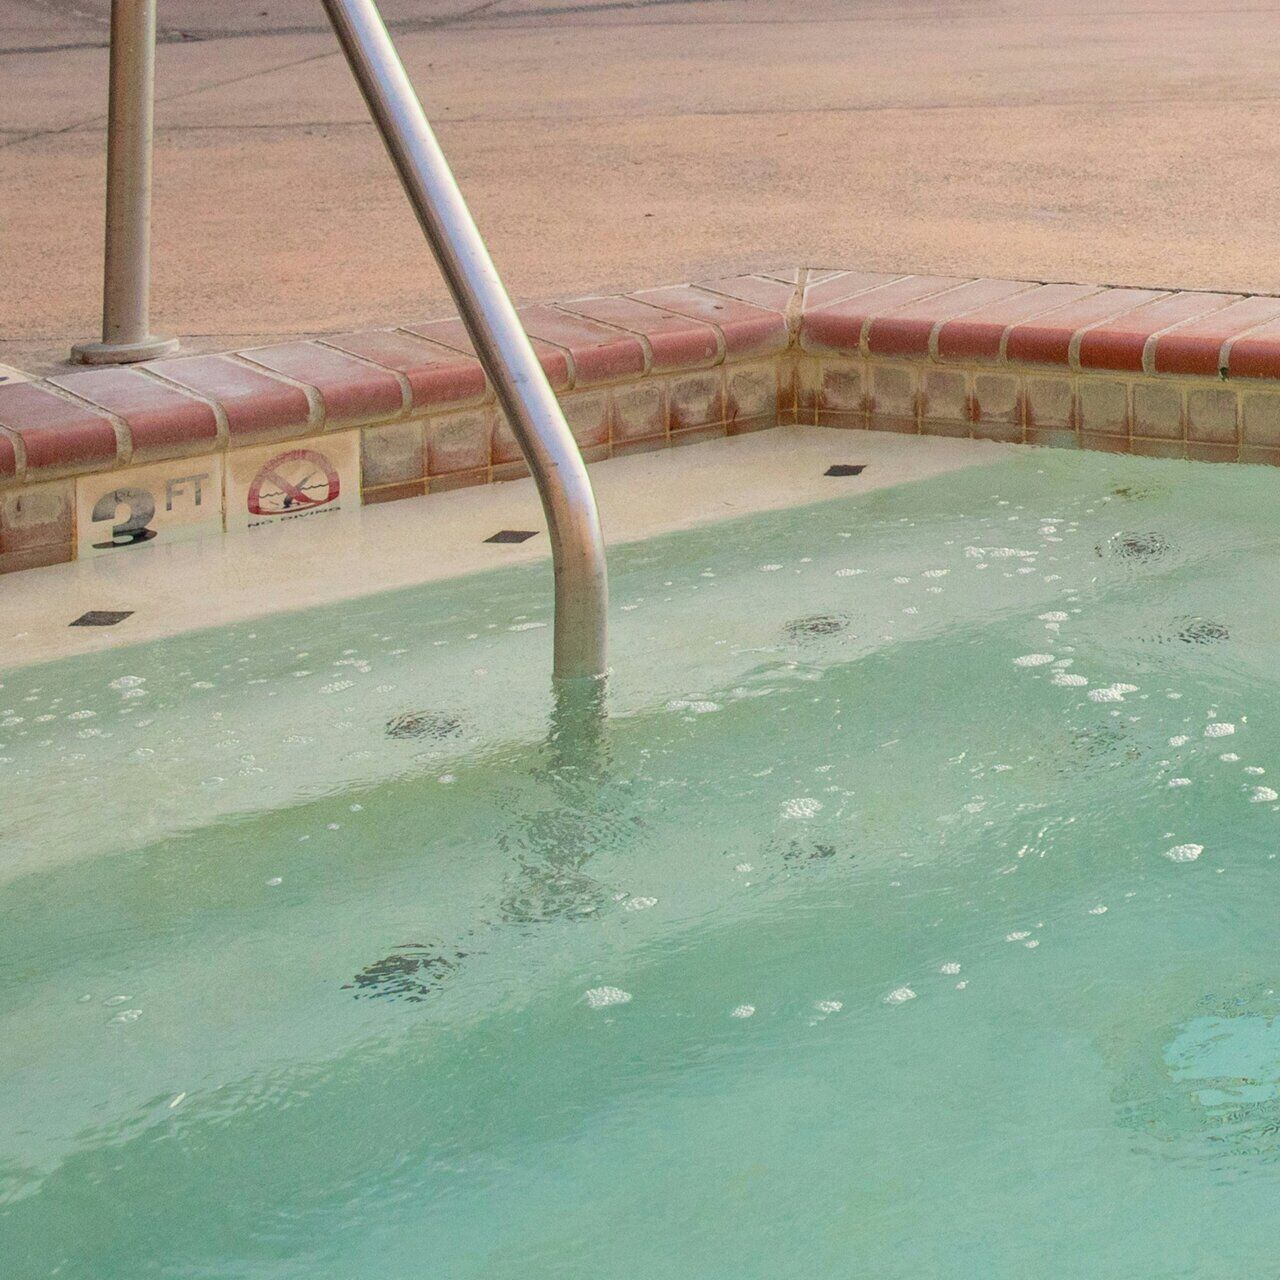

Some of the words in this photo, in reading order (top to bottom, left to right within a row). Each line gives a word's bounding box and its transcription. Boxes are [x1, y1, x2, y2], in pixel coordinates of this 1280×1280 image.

[91, 486, 158, 550] 3
[165, 472, 209, 511] FT
[247, 518, 273, 528] NO
[280, 506, 341, 523] DIVING
